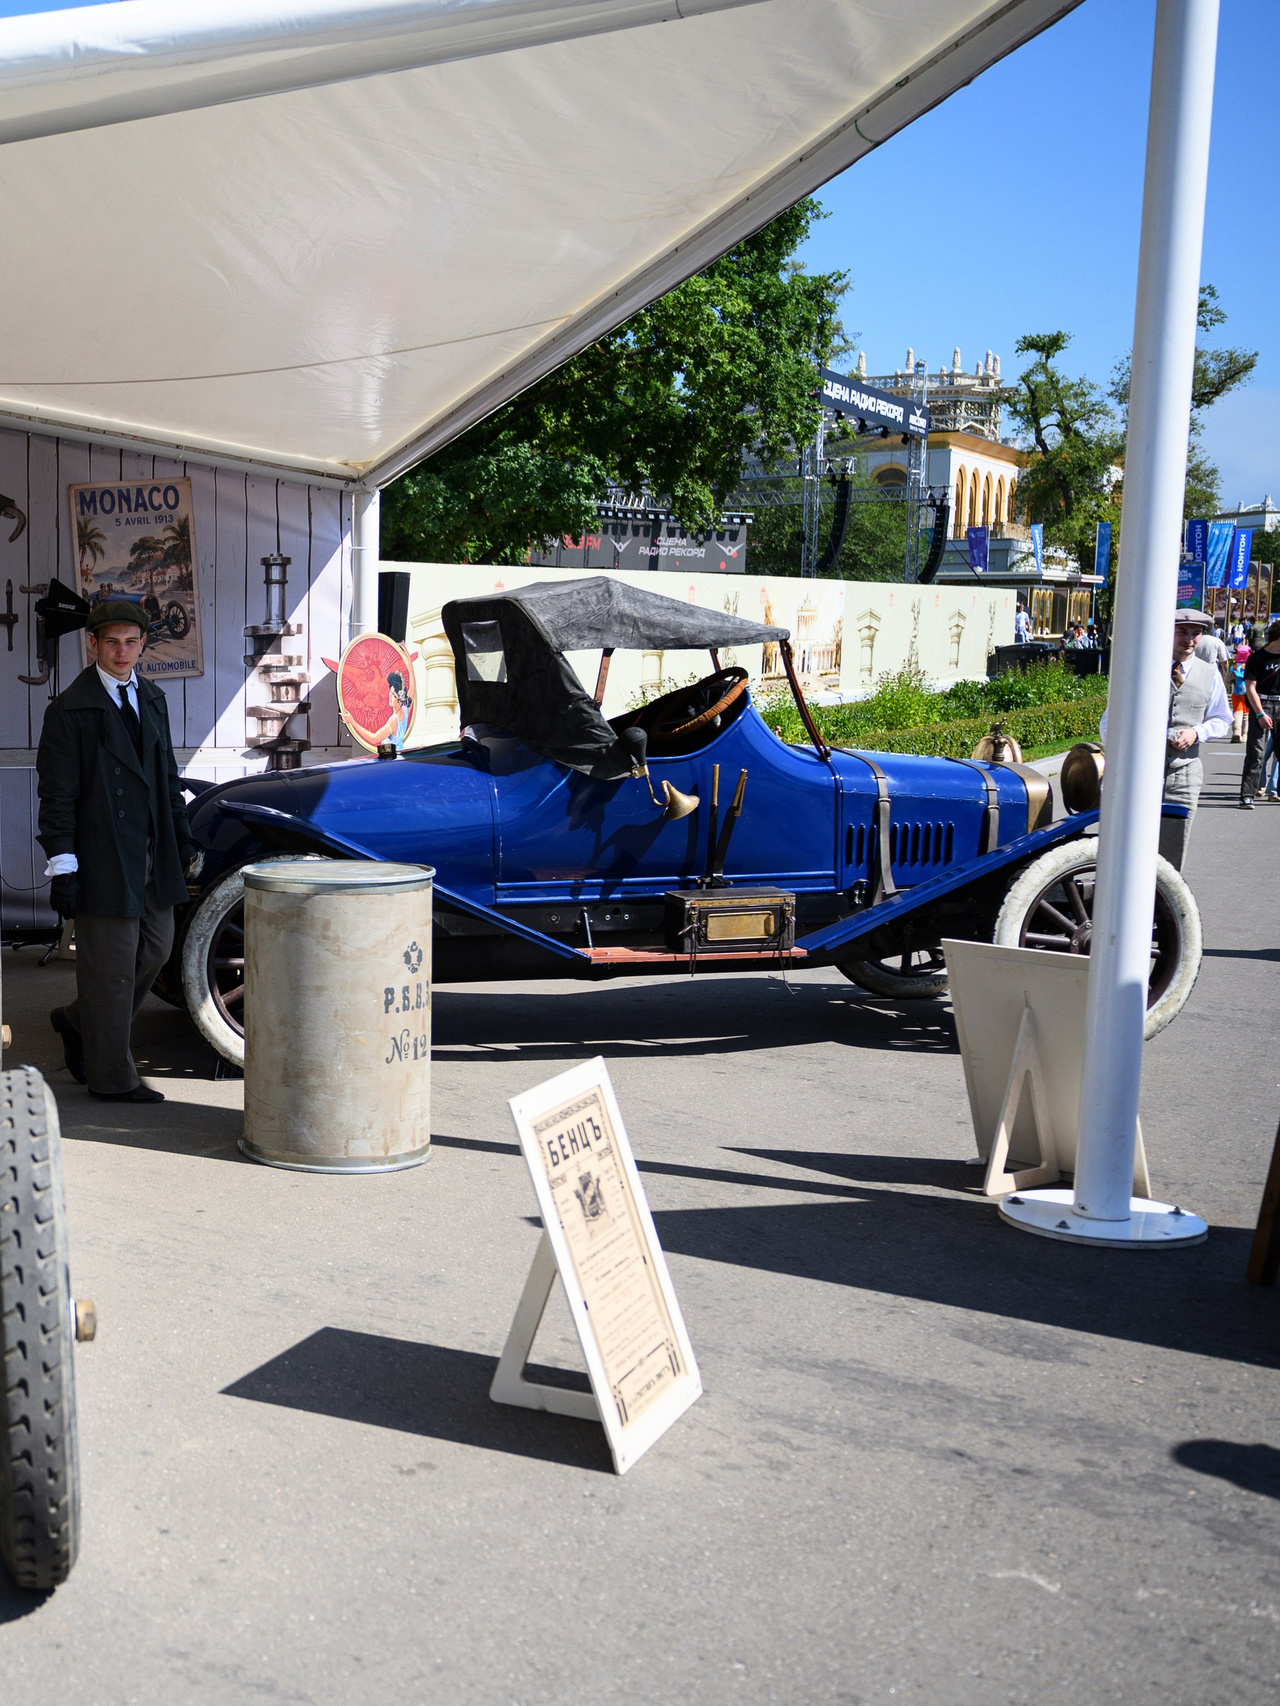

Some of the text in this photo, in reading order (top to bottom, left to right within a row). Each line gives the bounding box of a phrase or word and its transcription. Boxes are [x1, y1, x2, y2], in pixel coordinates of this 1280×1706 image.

[823, 379, 904, 423] СЦЕНА РАДИО РЕКОРД
[79, 485, 180, 516] MONACO
[115, 514, 174, 527] 5 AVRIL 1913
[585, 535, 601, 551] FM
[656, 537, 687, 547] СЦЕНА
[638, 546, 706, 558] РАДИО РЕКОРД
[147, 660, 197, 673] AUTOMOBILE
[546, 1116, 603, 1168] БЕНЦЪ
